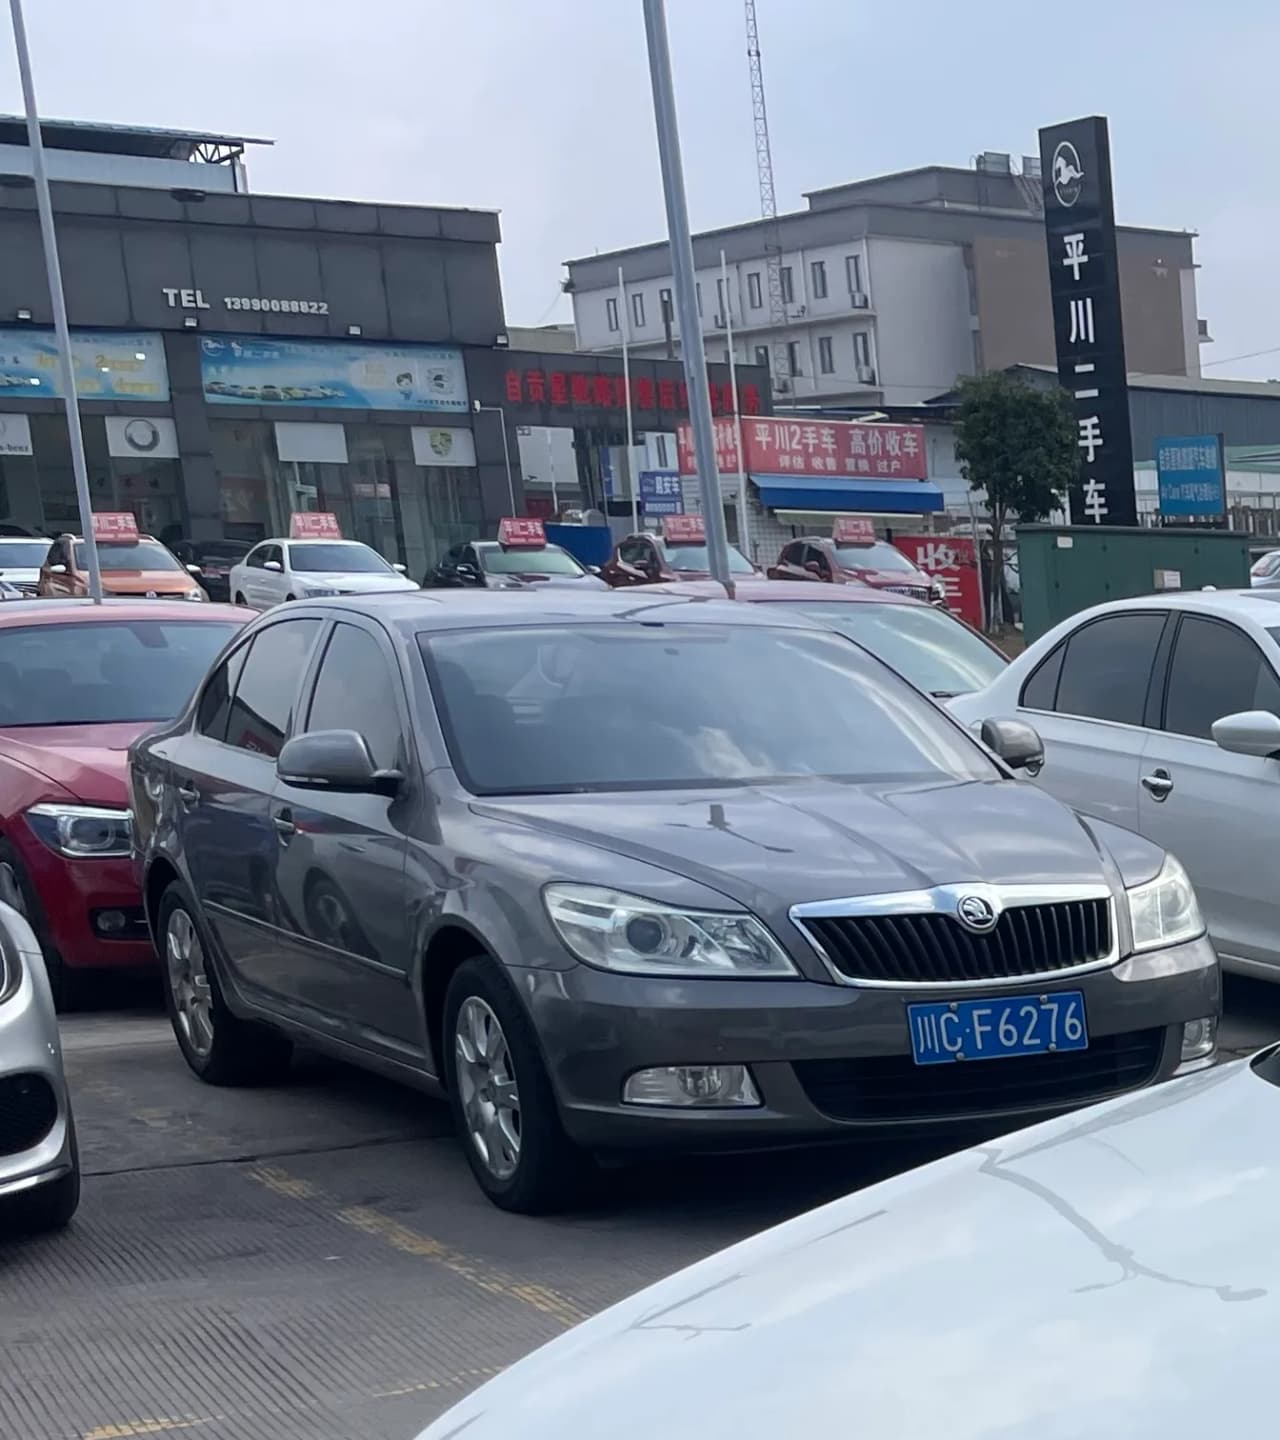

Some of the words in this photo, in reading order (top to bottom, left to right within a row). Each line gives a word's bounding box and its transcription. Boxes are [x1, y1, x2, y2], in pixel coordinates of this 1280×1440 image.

[162, 288, 211, 309] TEL
[1062, 233, 1108, 524] 平川二手车
[755, 423, 838, 455] 平川2手车
[849, 428, 919, 458] 高价收车
[877, 460, 902, 474] 过户
